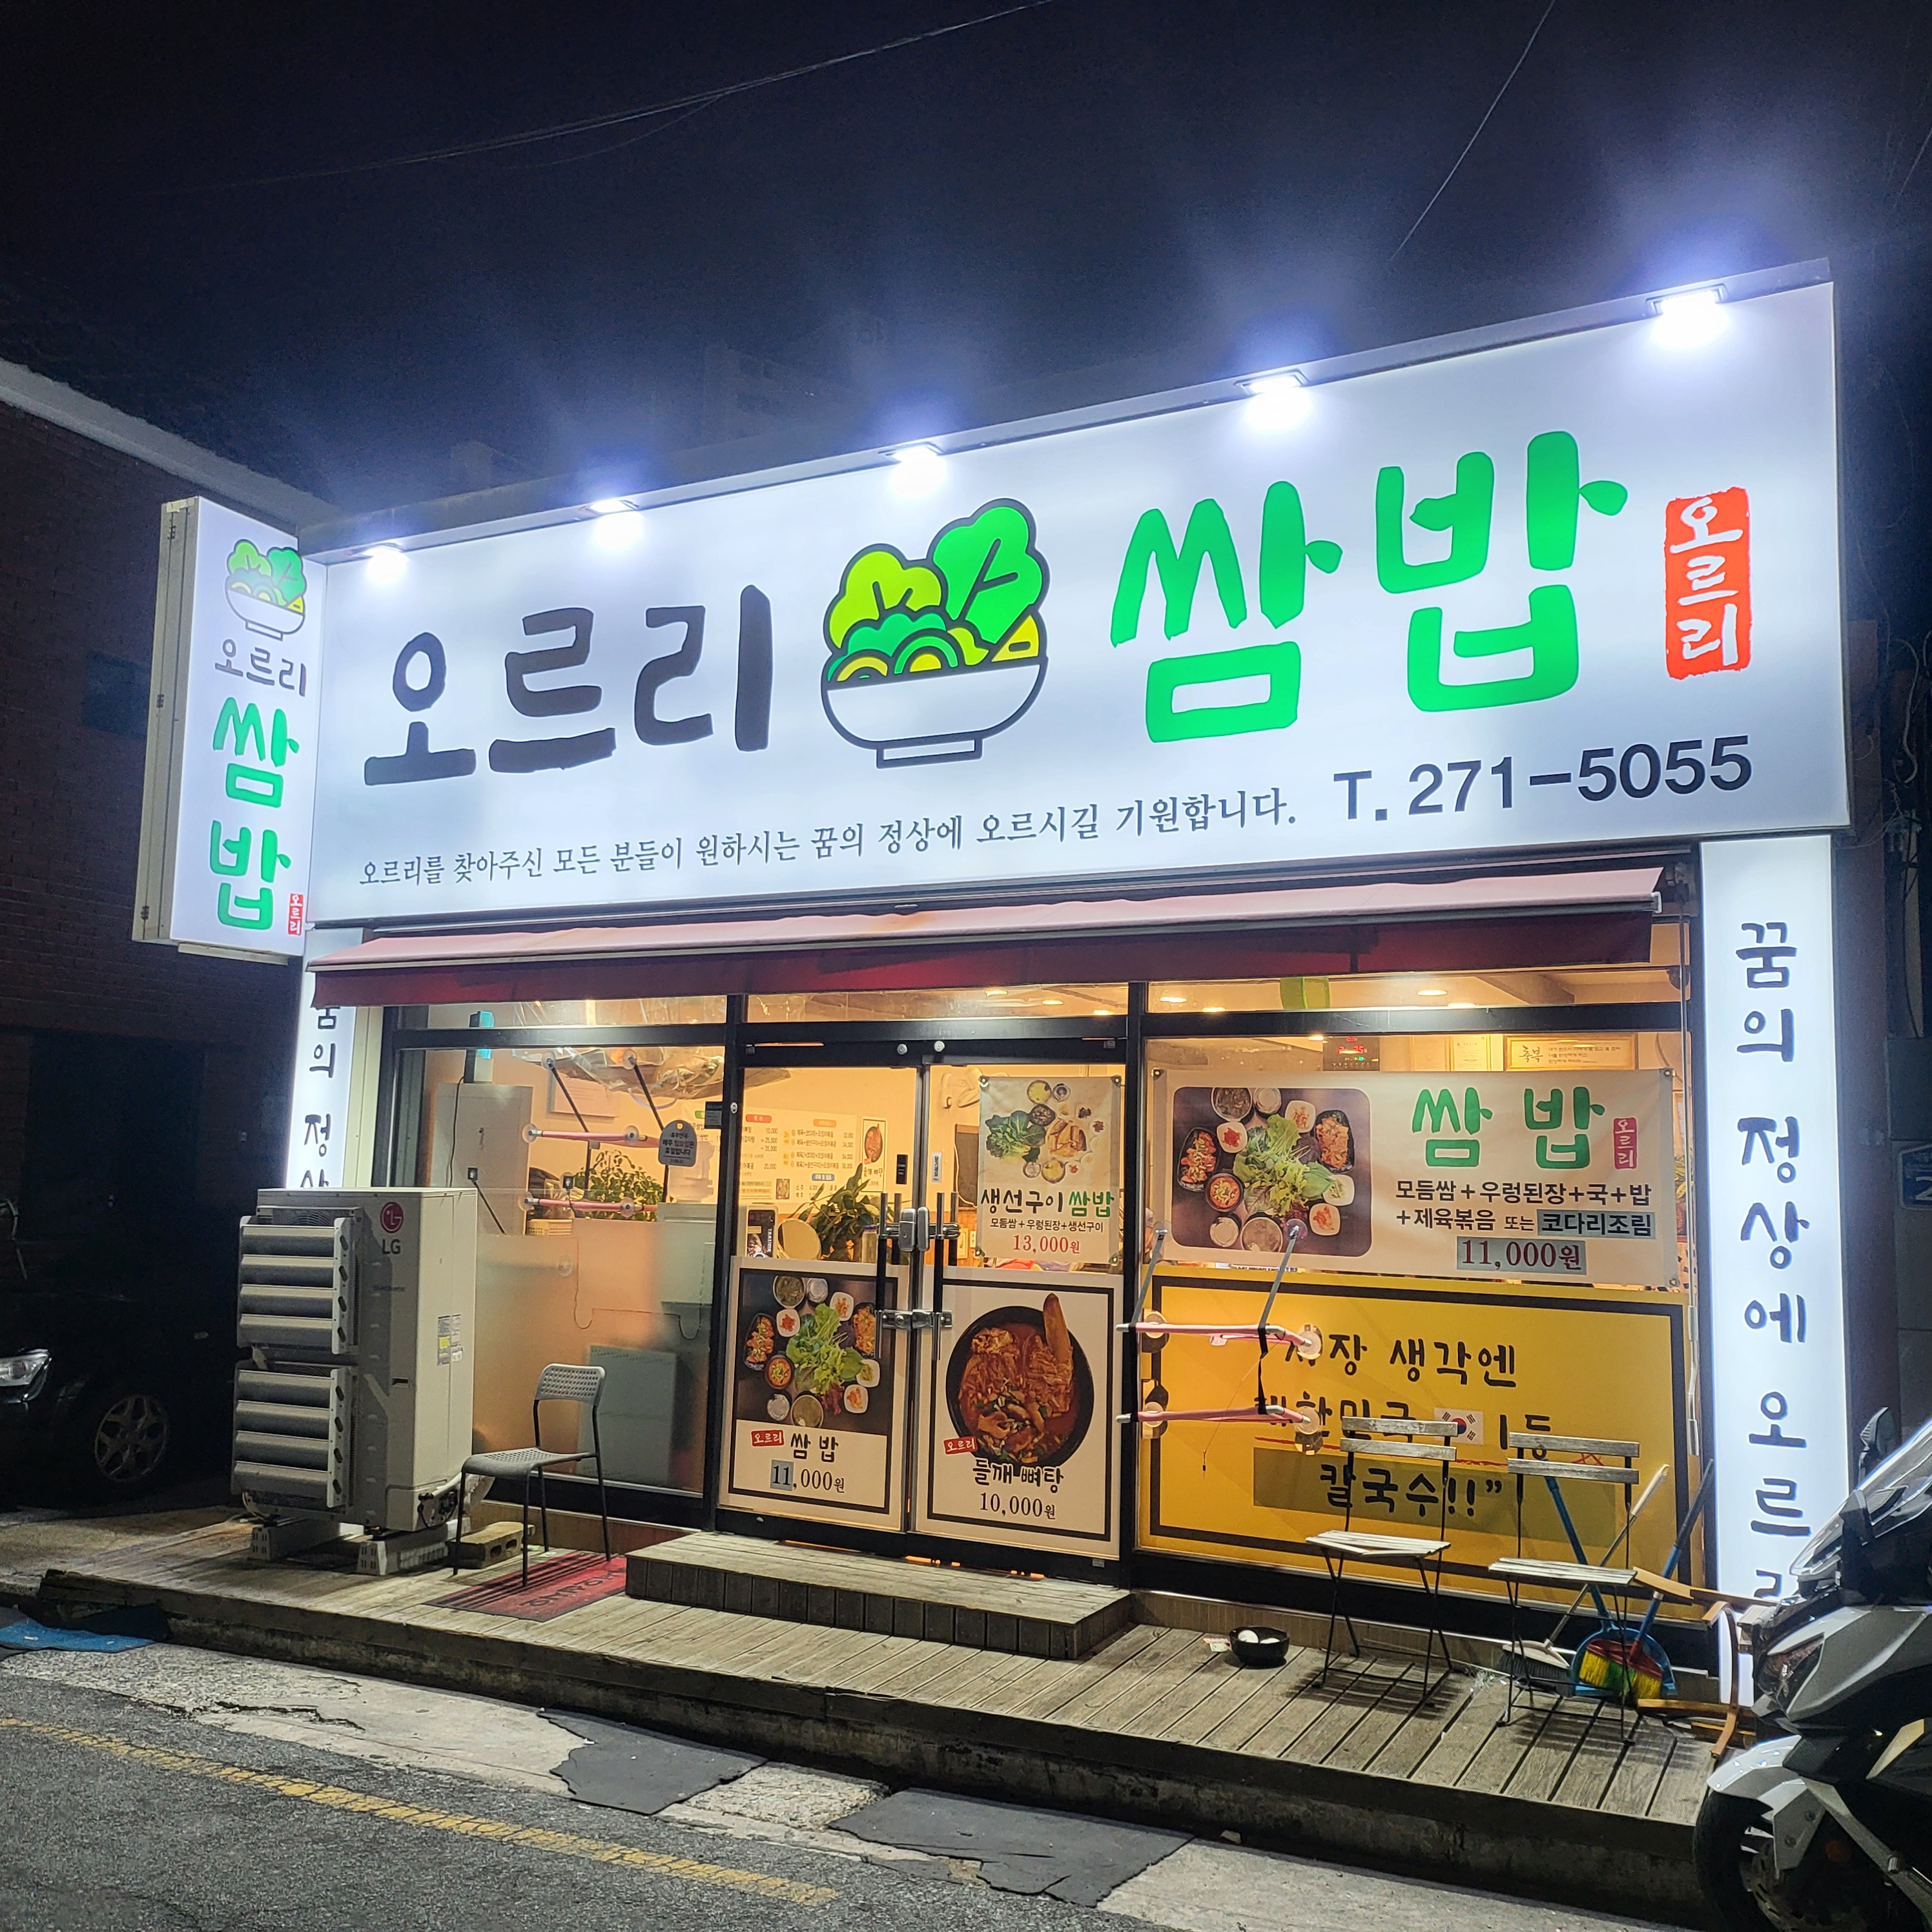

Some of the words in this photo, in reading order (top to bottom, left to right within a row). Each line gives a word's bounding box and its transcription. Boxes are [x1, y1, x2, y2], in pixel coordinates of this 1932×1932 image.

[1670, 495, 1744, 667] 오르리
[214, 639, 307, 697] 오르리
[364, 584, 773, 785] 오르리
[1408, 735, 1752, 815] 271-5055
[210, 697, 300, 930] 쌈밥
[359, 856, 444, 886] 오르리를
[453, 847, 543, 884] 찾아주신
[553, 843, 601, 875] 모든
[610, 837, 682, 872] 분들이
[696, 830, 801, 868] 원하시는
[810, 823, 864, 859] 꿈의
[878, 816, 963, 854] 정상에
[976, 803, 1099, 843] 오르시길
[1116, 787, 1297, 836] 기원합니다.
[289, 894, 303, 935] 오르리
[1736, 922, 1798, 1063] 꿈의
[1614, 1119, 1635, 1168] 오르리
[981, 1188, 1063, 1214] 생선구이
[1069, 1191, 1115, 1217] 쌈밥
[1504, 1215, 1536, 1232] 또는
[1541, 1211, 1654, 1237] 코다리조림
[382, 1239, 401, 1255] LG
[1012, 1235, 1081, 1255] 13,000원
[1737, 1116, 1810, 1343] 정상에
[1462, 1239, 1583, 1271] 11,000원
[1390, 1338, 1516, 1388] 생각엔
[754, 1432, 783, 1444] 오르리
[946, 1438, 976, 1454] 오르리
[772, 1465, 845, 1493] 11,000원
[980, 1492, 1056, 1519] 10,000원
